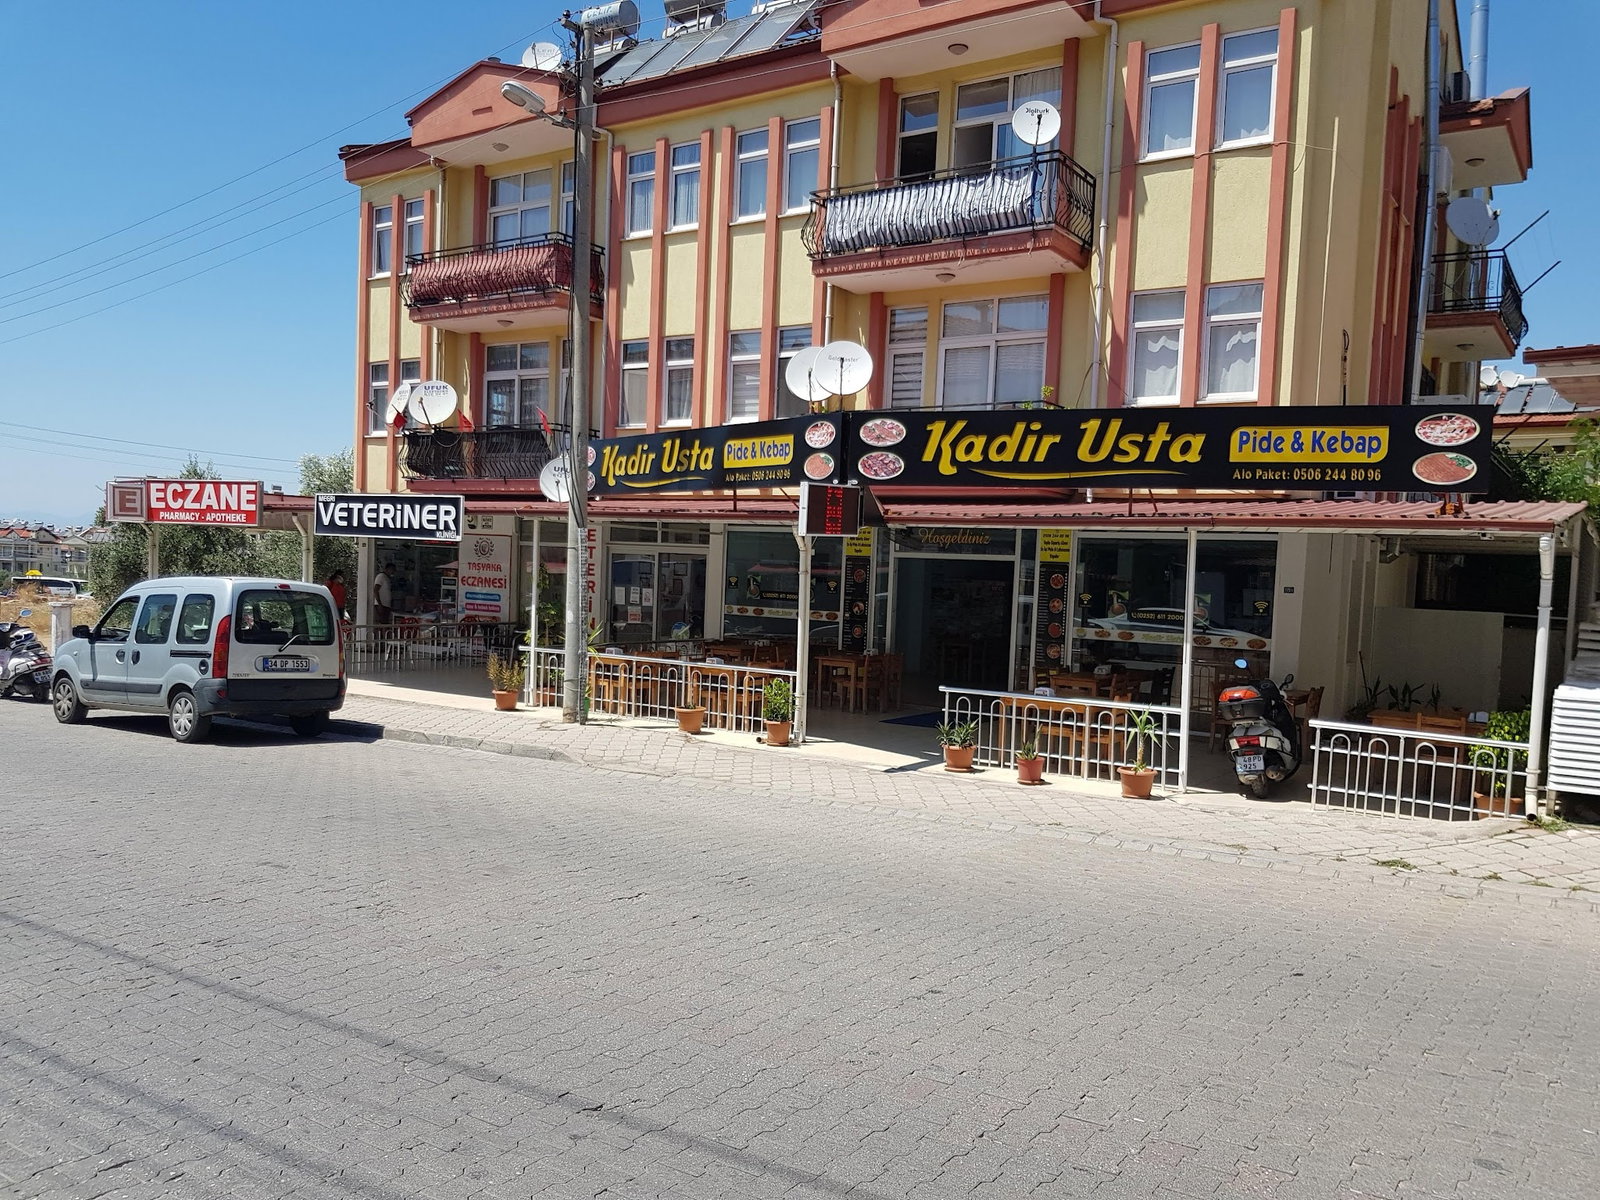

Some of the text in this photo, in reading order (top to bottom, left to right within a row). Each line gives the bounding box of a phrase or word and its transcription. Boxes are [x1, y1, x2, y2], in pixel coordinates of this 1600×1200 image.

[727, 440, 790, 461] Pide & Kebap
[921, 417, 1207, 476] Kadir Usta
[1237, 430, 1382, 459] Pide & Kebap
[601, 438, 714, 487] Kadir Usta
[751, 471, 764, 480] 0506
[765, 470, 775, 480] 244
[1232, 468, 1381, 481] Alo Paket: 0506 244 80 96
[150, 483, 257, 511] ECZANE
[159, 512, 200, 521] PHARMACY
[205, 513, 246, 523] APOTHEKE
[918, 527, 992, 549] Hoşgeldiniz
[467, 562, 502, 573] TAŞYAKA
[461, 575, 507, 589] ECZANESİ
[269, 660, 308, 668] 34 DP 1553
